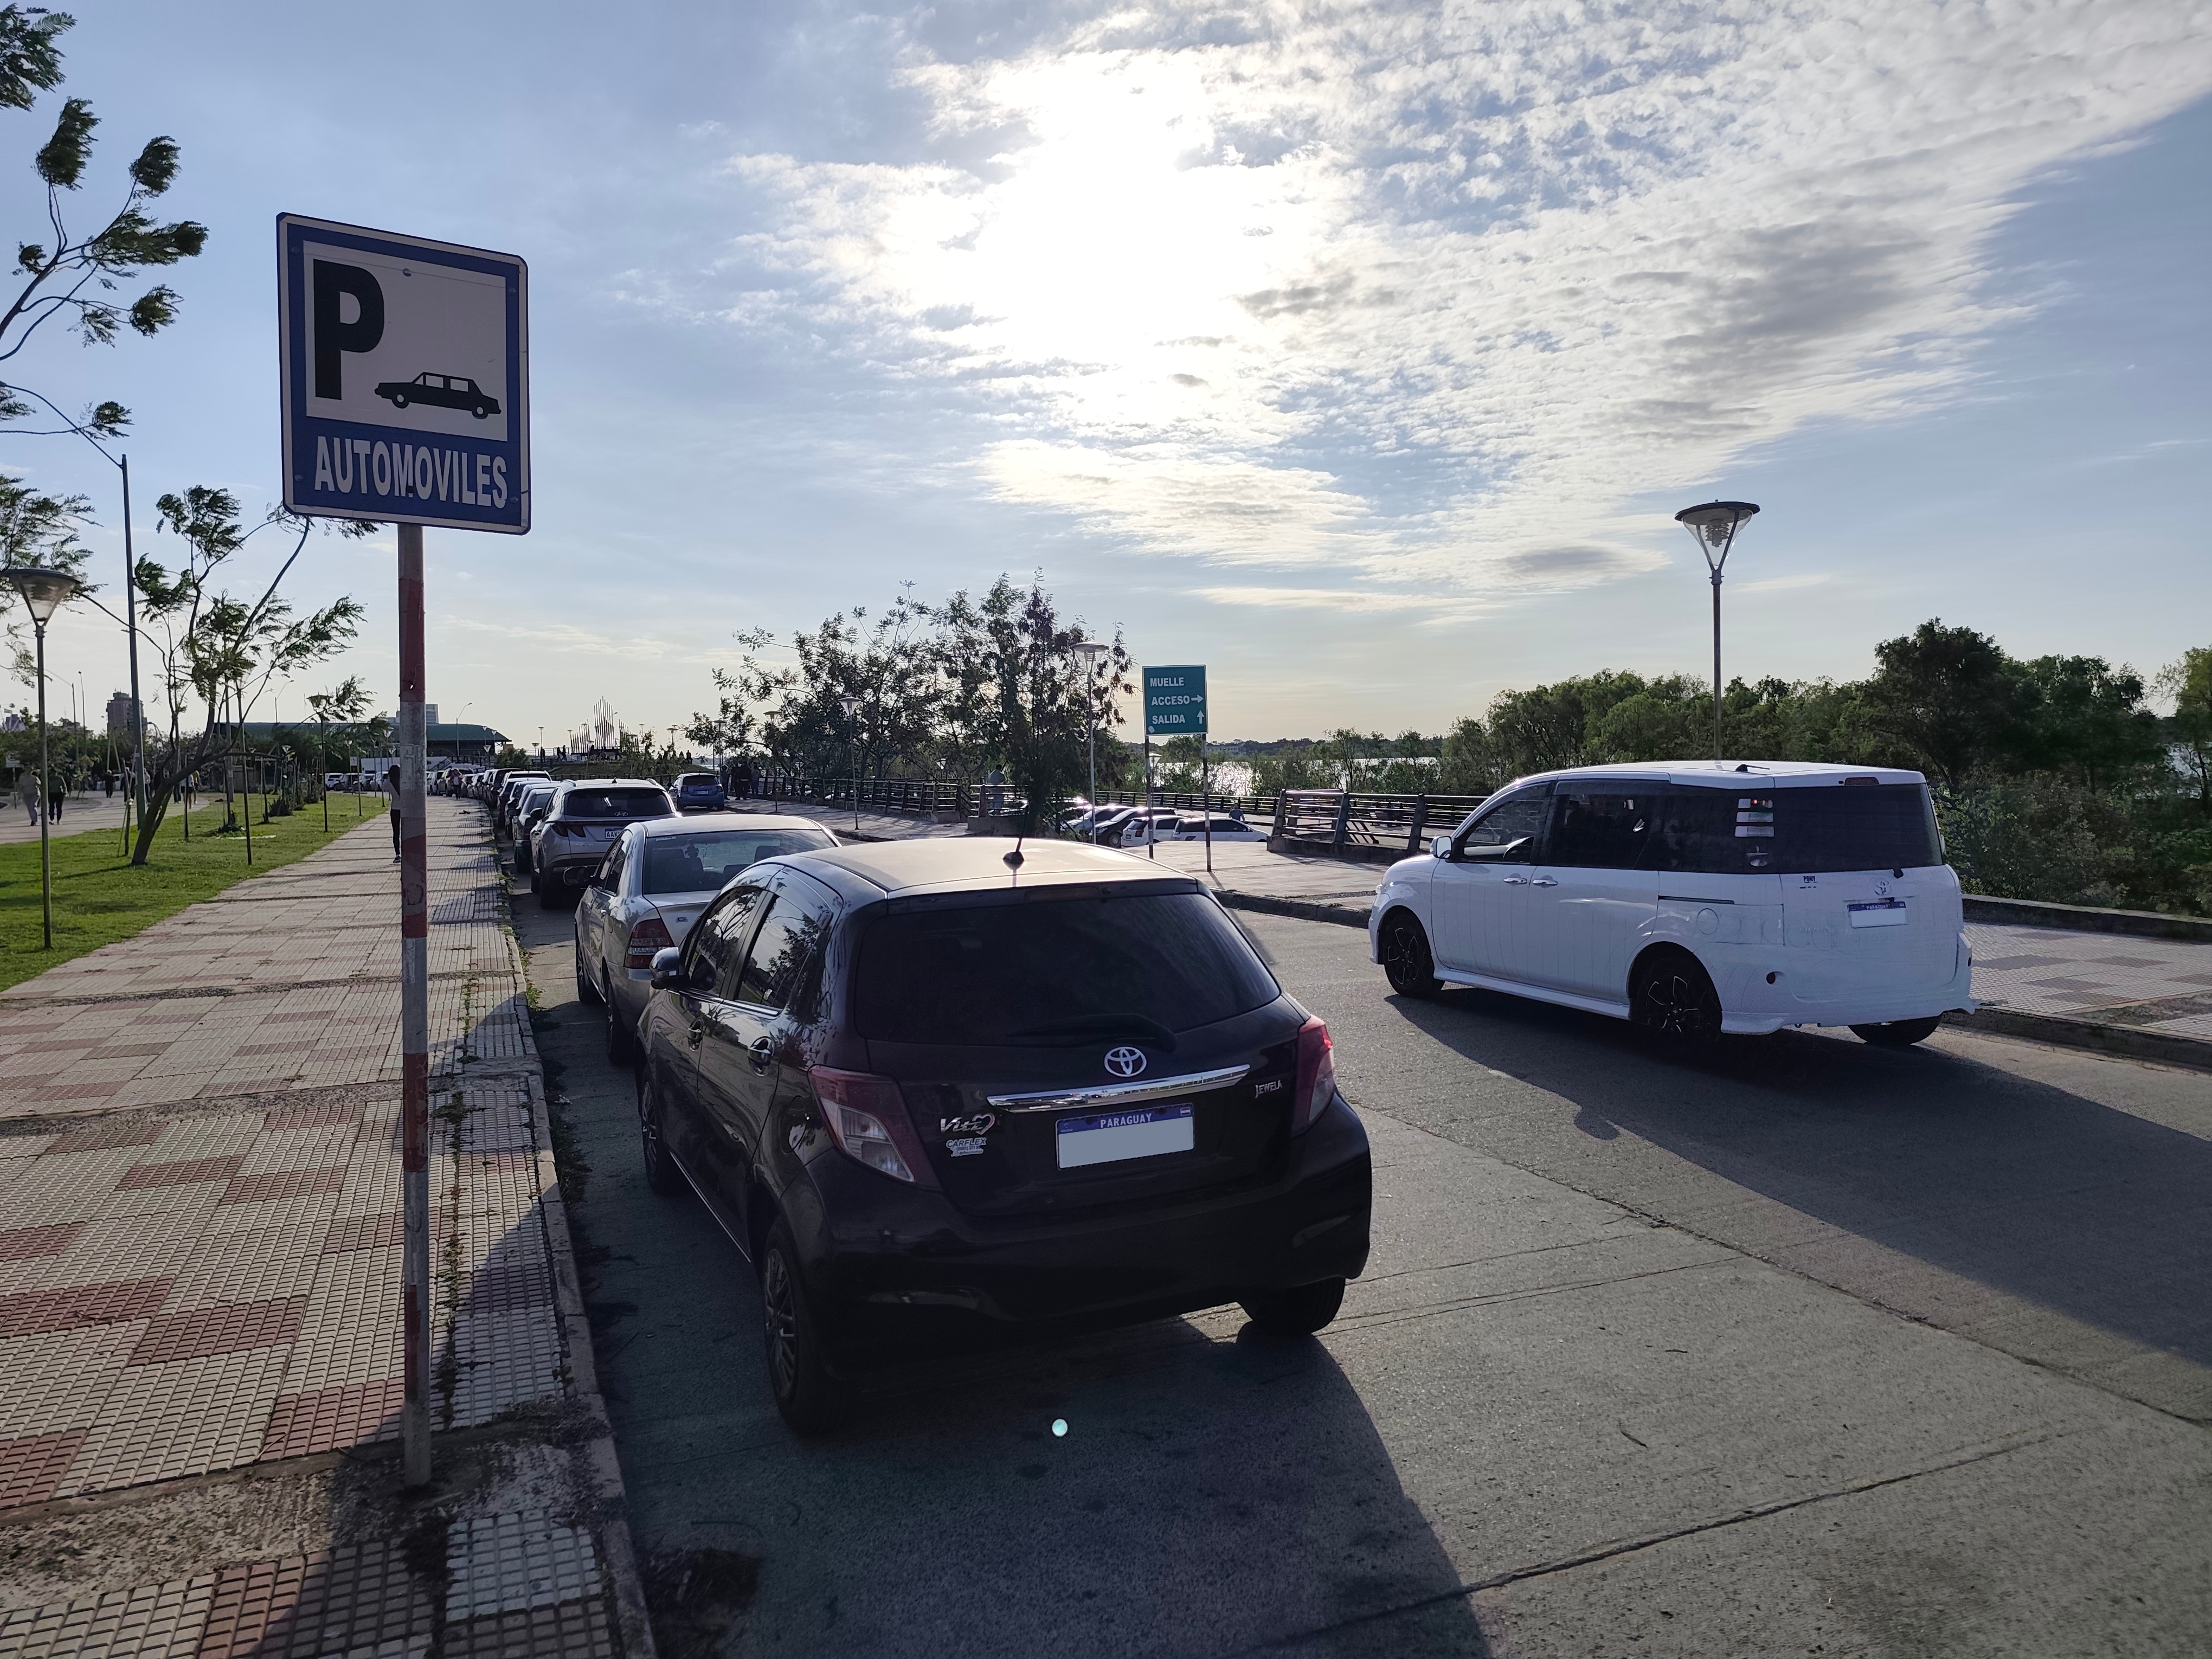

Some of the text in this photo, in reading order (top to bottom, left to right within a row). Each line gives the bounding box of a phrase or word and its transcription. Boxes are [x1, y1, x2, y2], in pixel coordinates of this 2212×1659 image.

[313, 258, 384, 401] P
[314, 436, 507, 509] AUTOMOVILES
[1150, 677, 1185, 687] MUELLE
[1151, 695, 1190, 706] ACCESO
[1152, 714, 1186, 724] SALIDA
[940, 1117, 983, 1133] Vitz
[1100, 1113, 1152, 1128] PARAGUAY
[947, 1138, 986, 1147] CARFLEX
